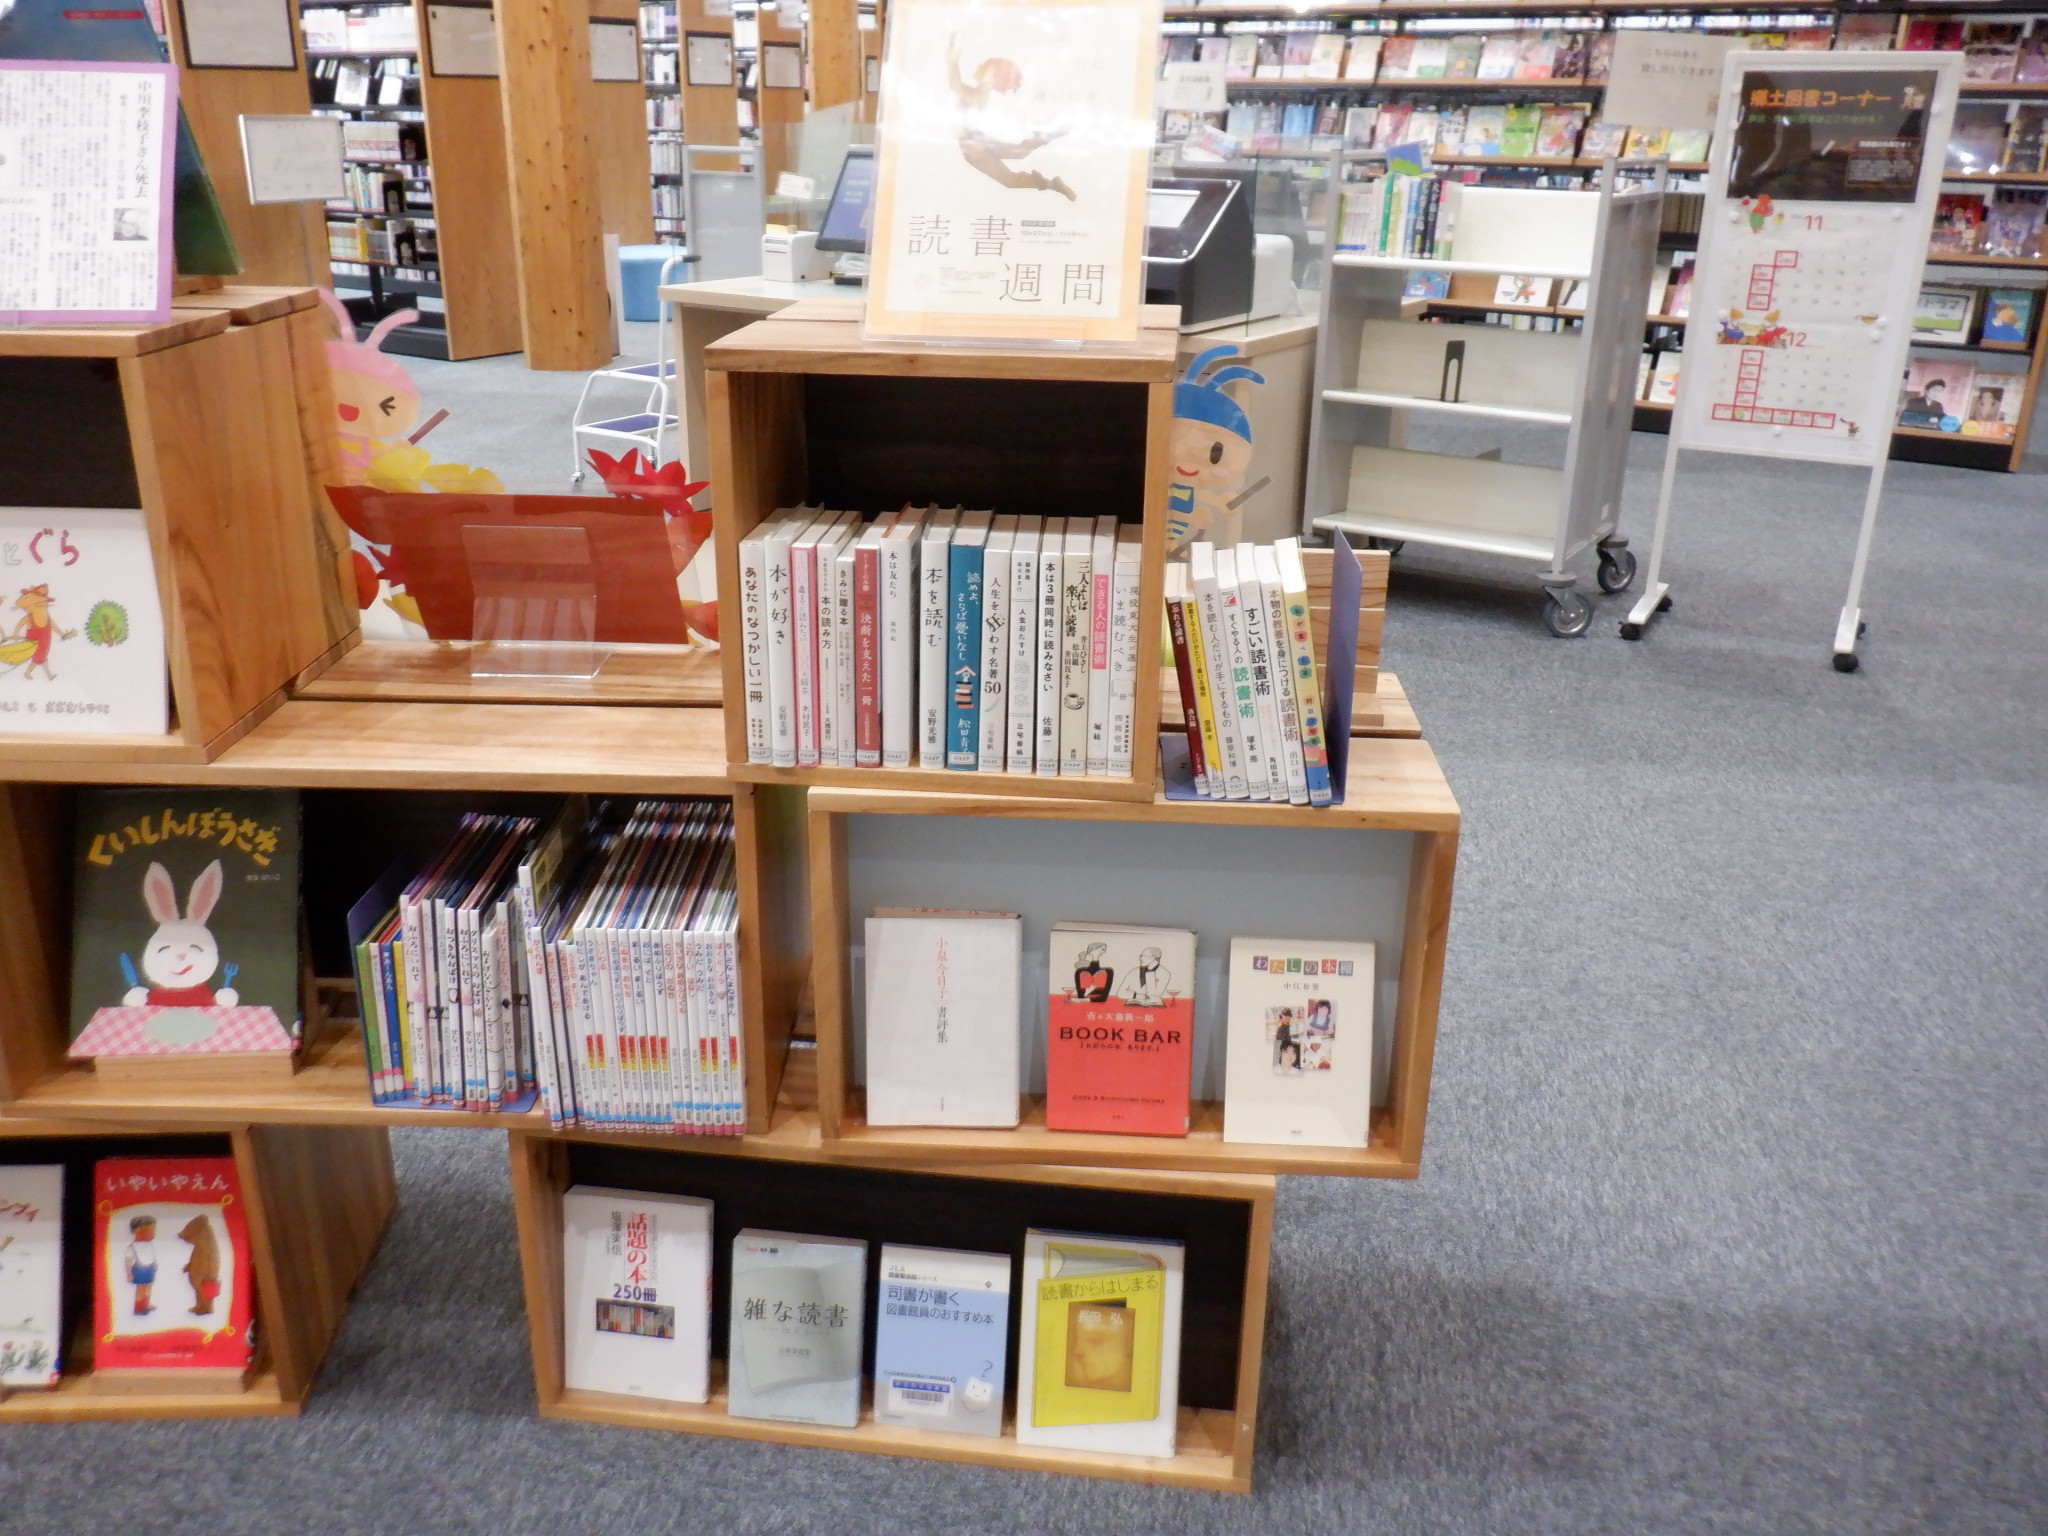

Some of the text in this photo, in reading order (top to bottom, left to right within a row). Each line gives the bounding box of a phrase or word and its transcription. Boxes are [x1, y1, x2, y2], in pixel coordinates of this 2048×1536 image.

[908, 214, 1013, 257] 読書
[1803, 215, 1824, 231] 11
[999, 263, 1105, 306] 週間
[1789, 332, 1807, 348] 12
[839, 569, 849, 625] きみに贈る本
[888, 551, 898, 598] 本は友だち
[967, 571, 981, 605] 読めよ、
[1077, 560, 1091, 611] 三人よれば
[769, 564, 790, 644] 本が好き
[820, 595, 832, 650] 本の読み方
[924, 568, 943, 648] 本を読む
[956, 592, 969, 661] さらば憂いなし
[1043, 562, 1056, 692] 本は3冊同時に読みなさい
[1065, 584, 1078, 638] 楽しい読書
[1093, 578, 1108, 665] できる人の読書術
[1113, 587, 1126, 671] いま読むべき
[744, 567, 763, 703] あなたのなつかしい一冊
[860, 613, 873, 706] 決断を支えた一冊
[1018, 609, 1027, 657] 人生おたすけ
[1203, 592, 1232, 728] 本を読む人だけが手にするもの
[1244, 606, 1270, 696] すごい読書術
[1229, 613, 1255, 719] すぐやる人の読書術
[1268, 588, 1299, 742] 本物の教養を身につける読書術
[928, 708, 937, 744] 安野光雅
[1042, 716, 1054, 743] 佐藤
[87, 807, 281, 867] くいしんぼうさぎ
[408, 925, 420, 981] おふろにいれて
[446, 927, 456, 984] おつきみおばけ
[460, 929, 471, 984] おふろにいれて
[470, 929, 480, 978] クリスマスの
[653, 941, 664, 995] あめふりぼうず
[1253, 956, 1353, 976] わたしの本棚
[936, 1005, 949, 1044] 書評集
[1060, 1027, 1181, 1044] BOOK BAR
[106, 1173, 229, 1193] いやいやえん
[626, 1212, 648, 1284] 話題の本
[613, 1283, 657, 1303] 250冊
[744, 1297, 849, 1328] 雑な読書
[886, 1302, 995, 1325] 図書館員のおすすめ本
[888, 1285, 960, 1306] 司書が書く
[1042, 1275, 1160, 1300] 読書からはじまる
